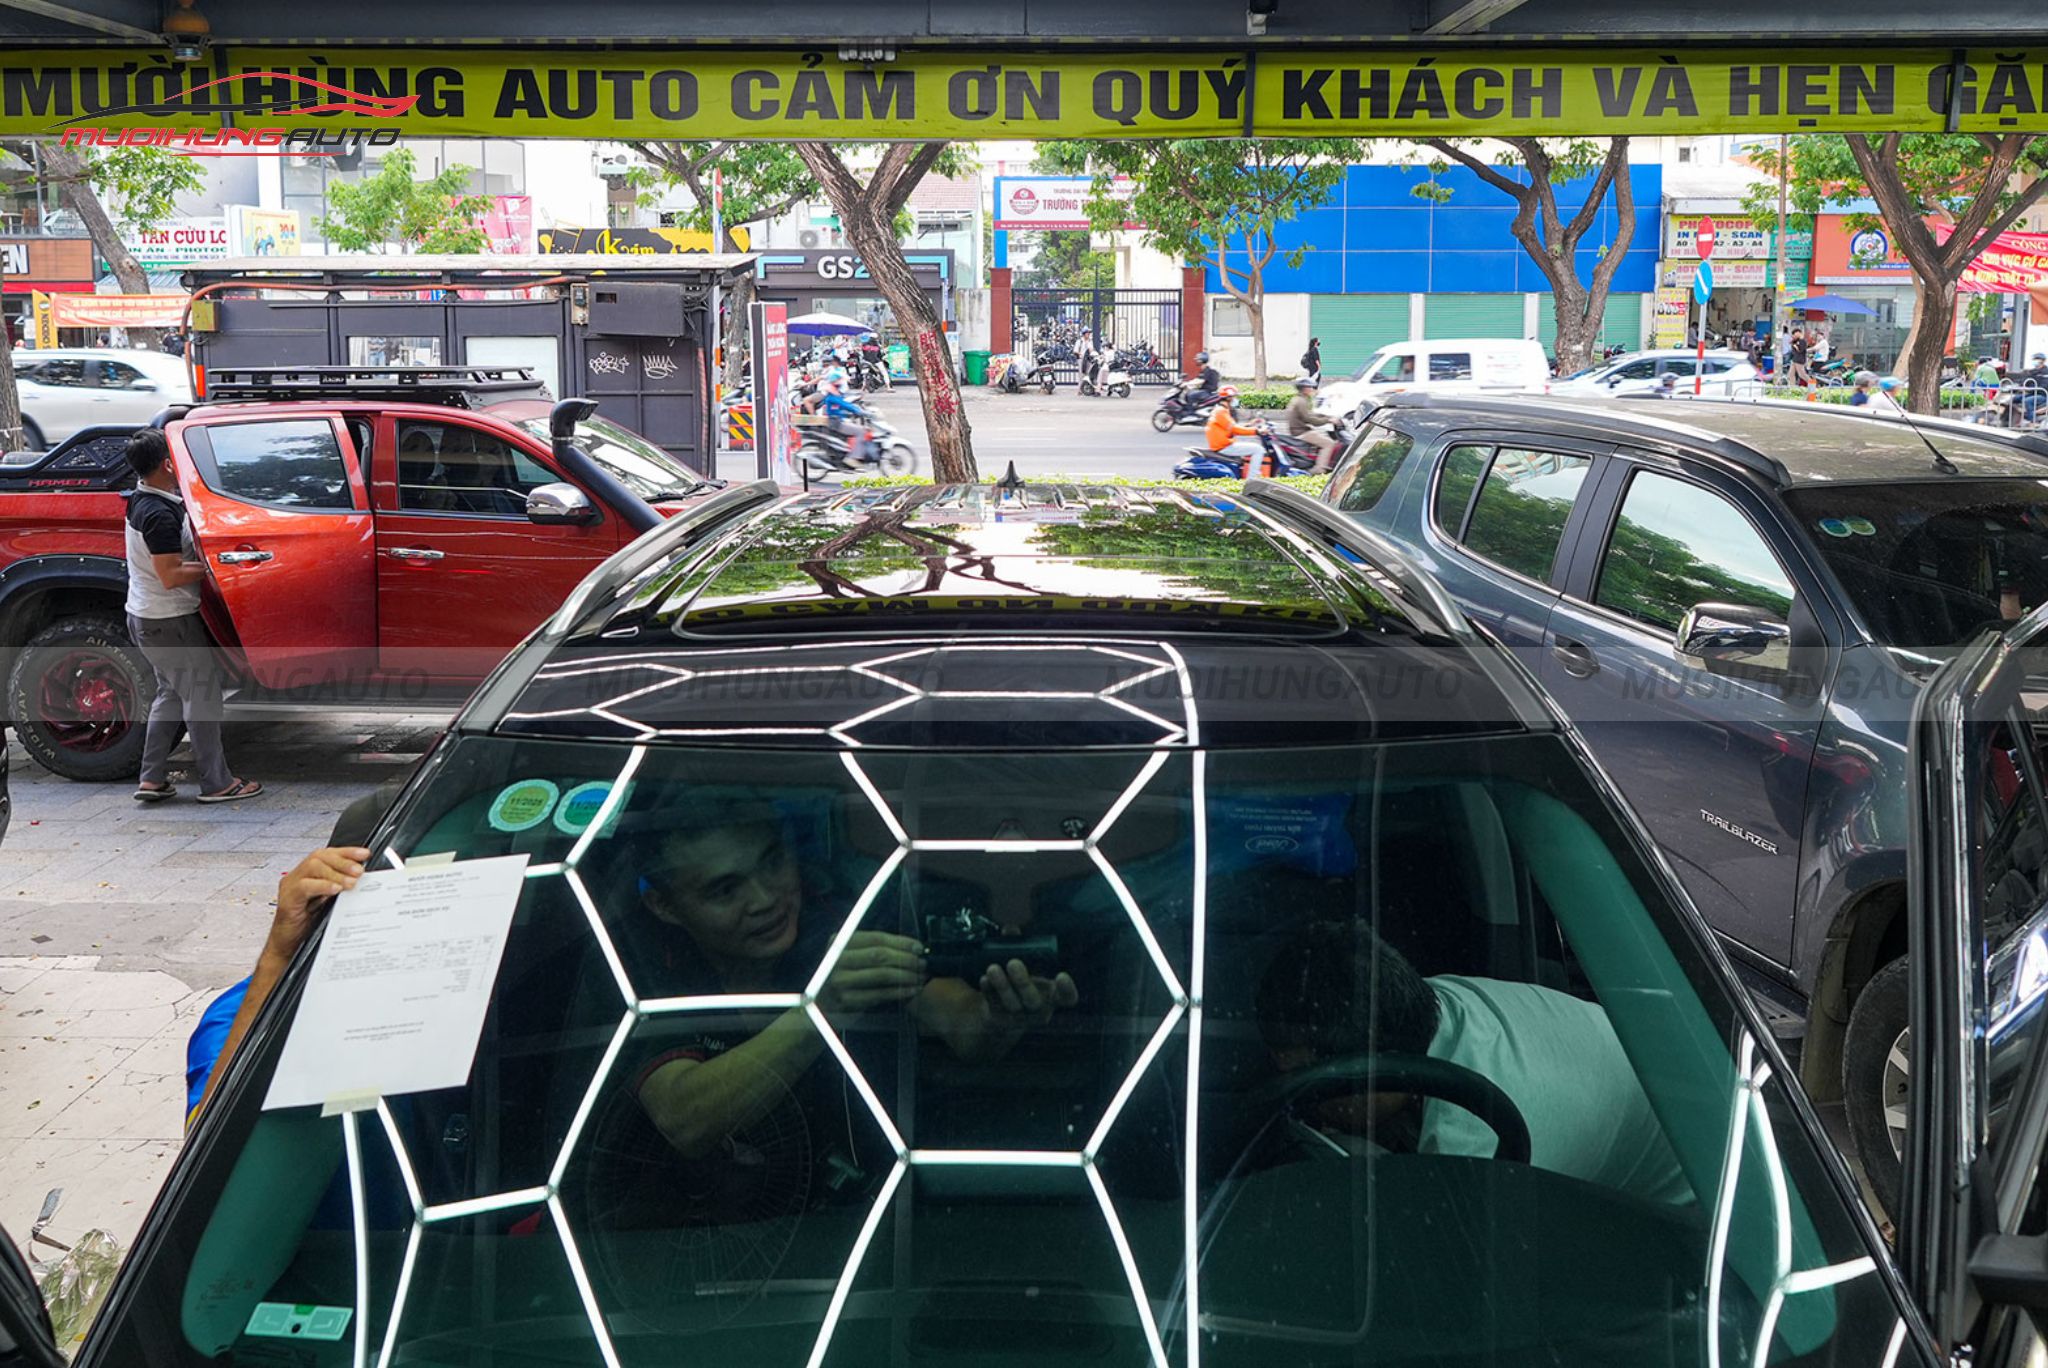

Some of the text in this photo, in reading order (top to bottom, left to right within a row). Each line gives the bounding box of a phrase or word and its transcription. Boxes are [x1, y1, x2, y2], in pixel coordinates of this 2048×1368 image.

[2, 52, 2048, 127] MƯỜI HÙNG AUTO CẢM ƠN QUÝ KHÁCH VÀ HẸN GẶ
[1700, 808, 1777, 855] TRAILBLAZER
